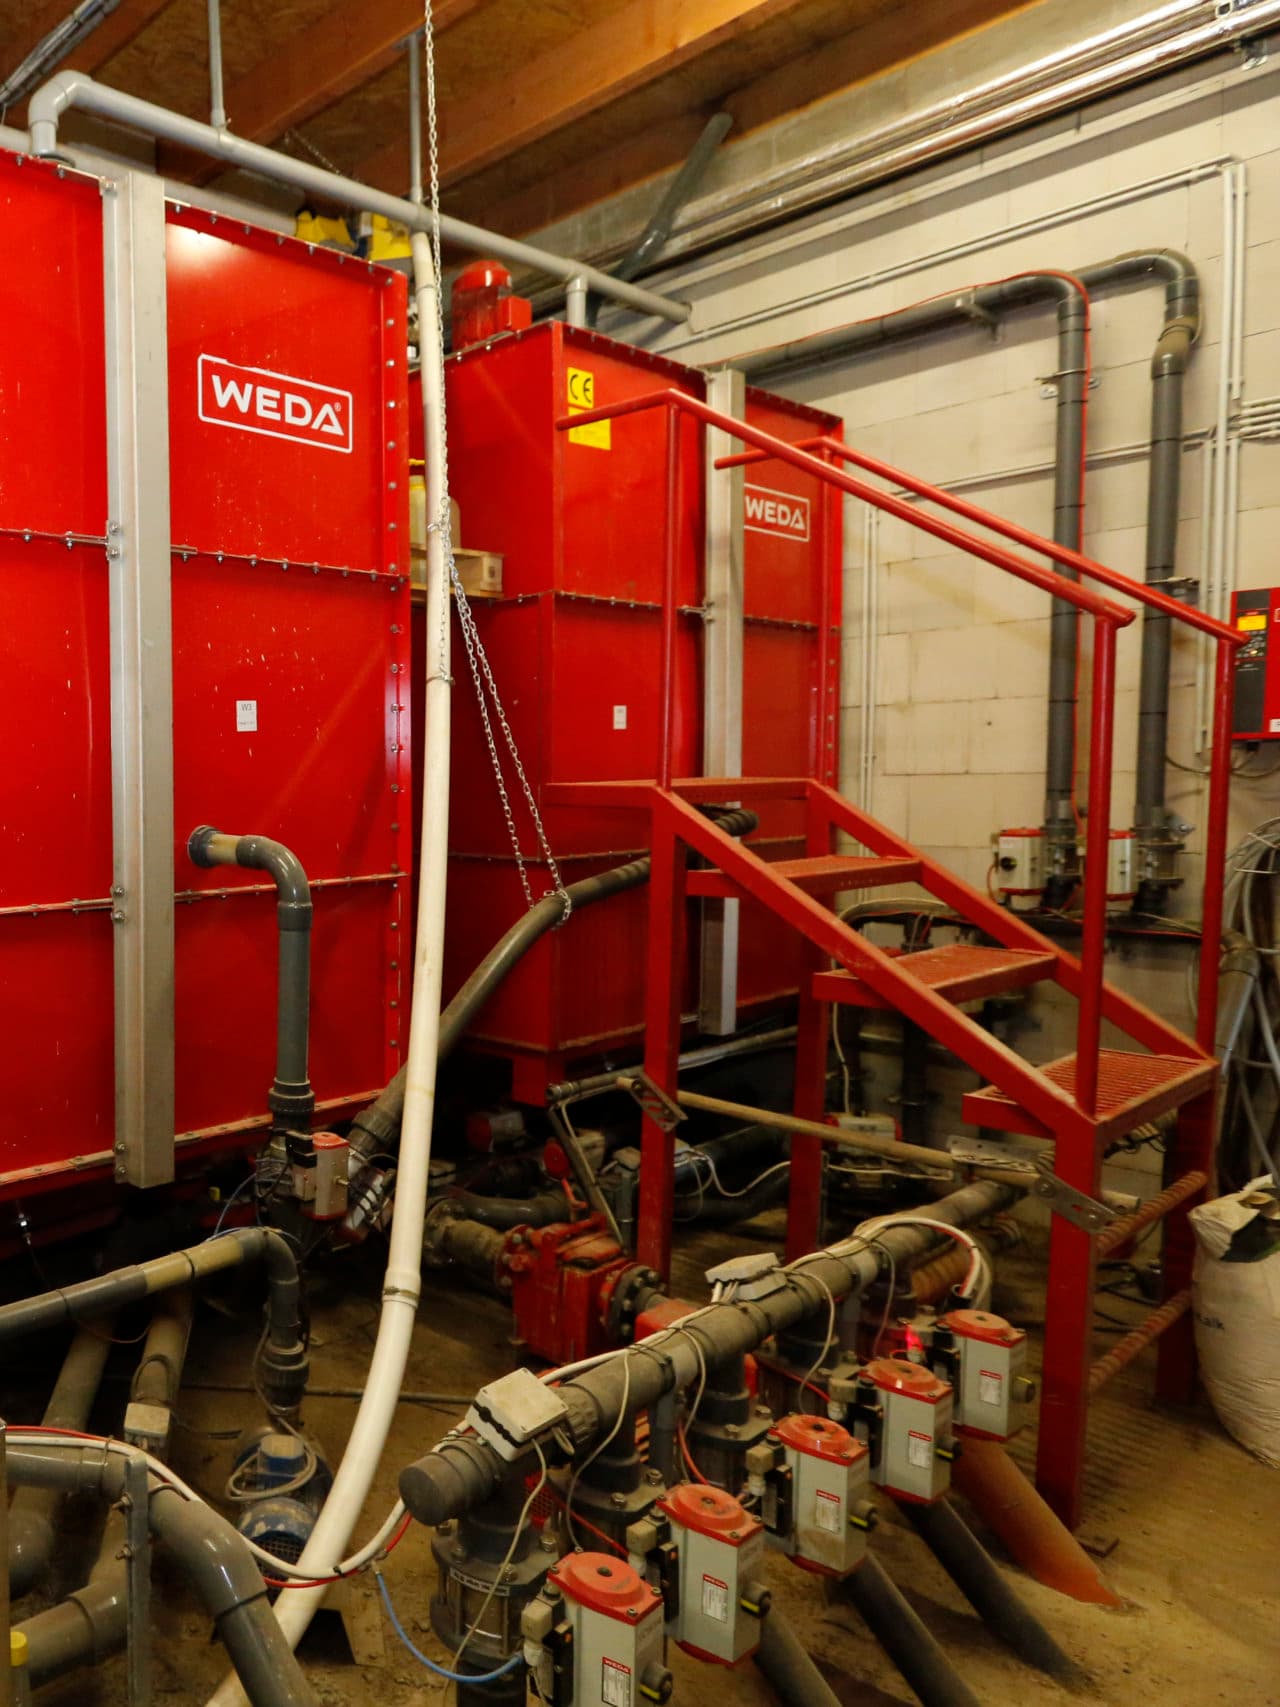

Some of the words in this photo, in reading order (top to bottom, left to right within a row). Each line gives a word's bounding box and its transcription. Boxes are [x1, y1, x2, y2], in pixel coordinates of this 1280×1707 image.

[211, 374, 345, 436] WEDA
[570, 373, 592, 404] CE
[745, 495, 806, 531] WEDA
